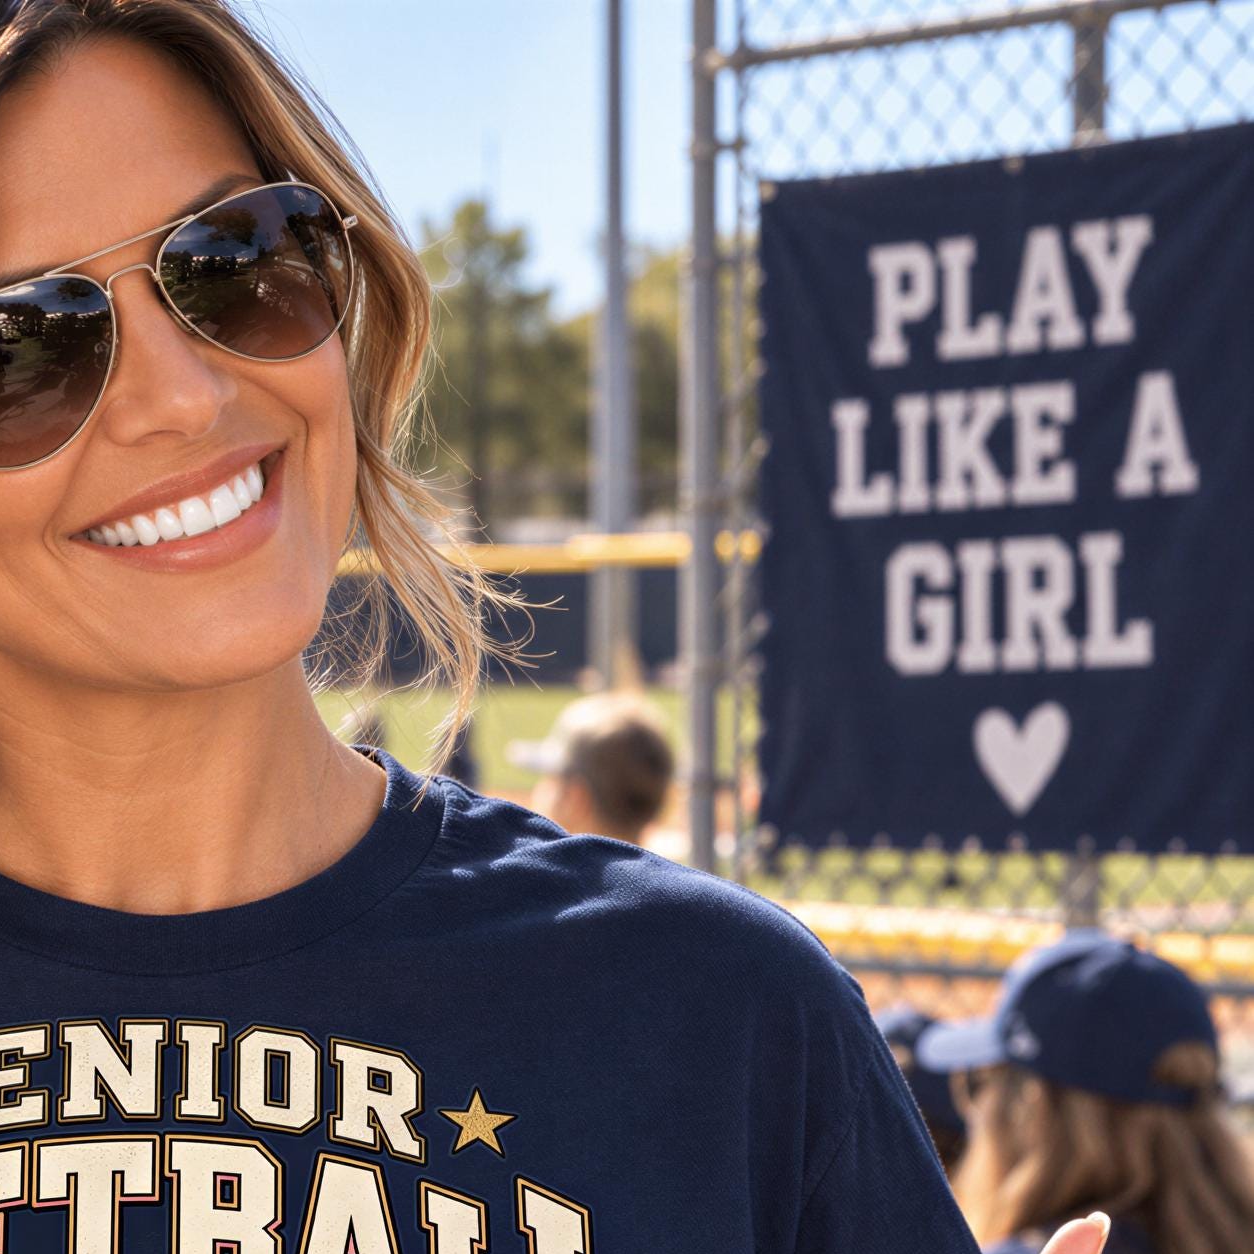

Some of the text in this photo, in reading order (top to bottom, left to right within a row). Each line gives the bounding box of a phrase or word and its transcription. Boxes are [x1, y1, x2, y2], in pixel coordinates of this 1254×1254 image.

[868, 216, 1153, 366] PLAY
[832, 369, 1199, 517] LIKE A
[884, 531, 1154, 675] GIRL
